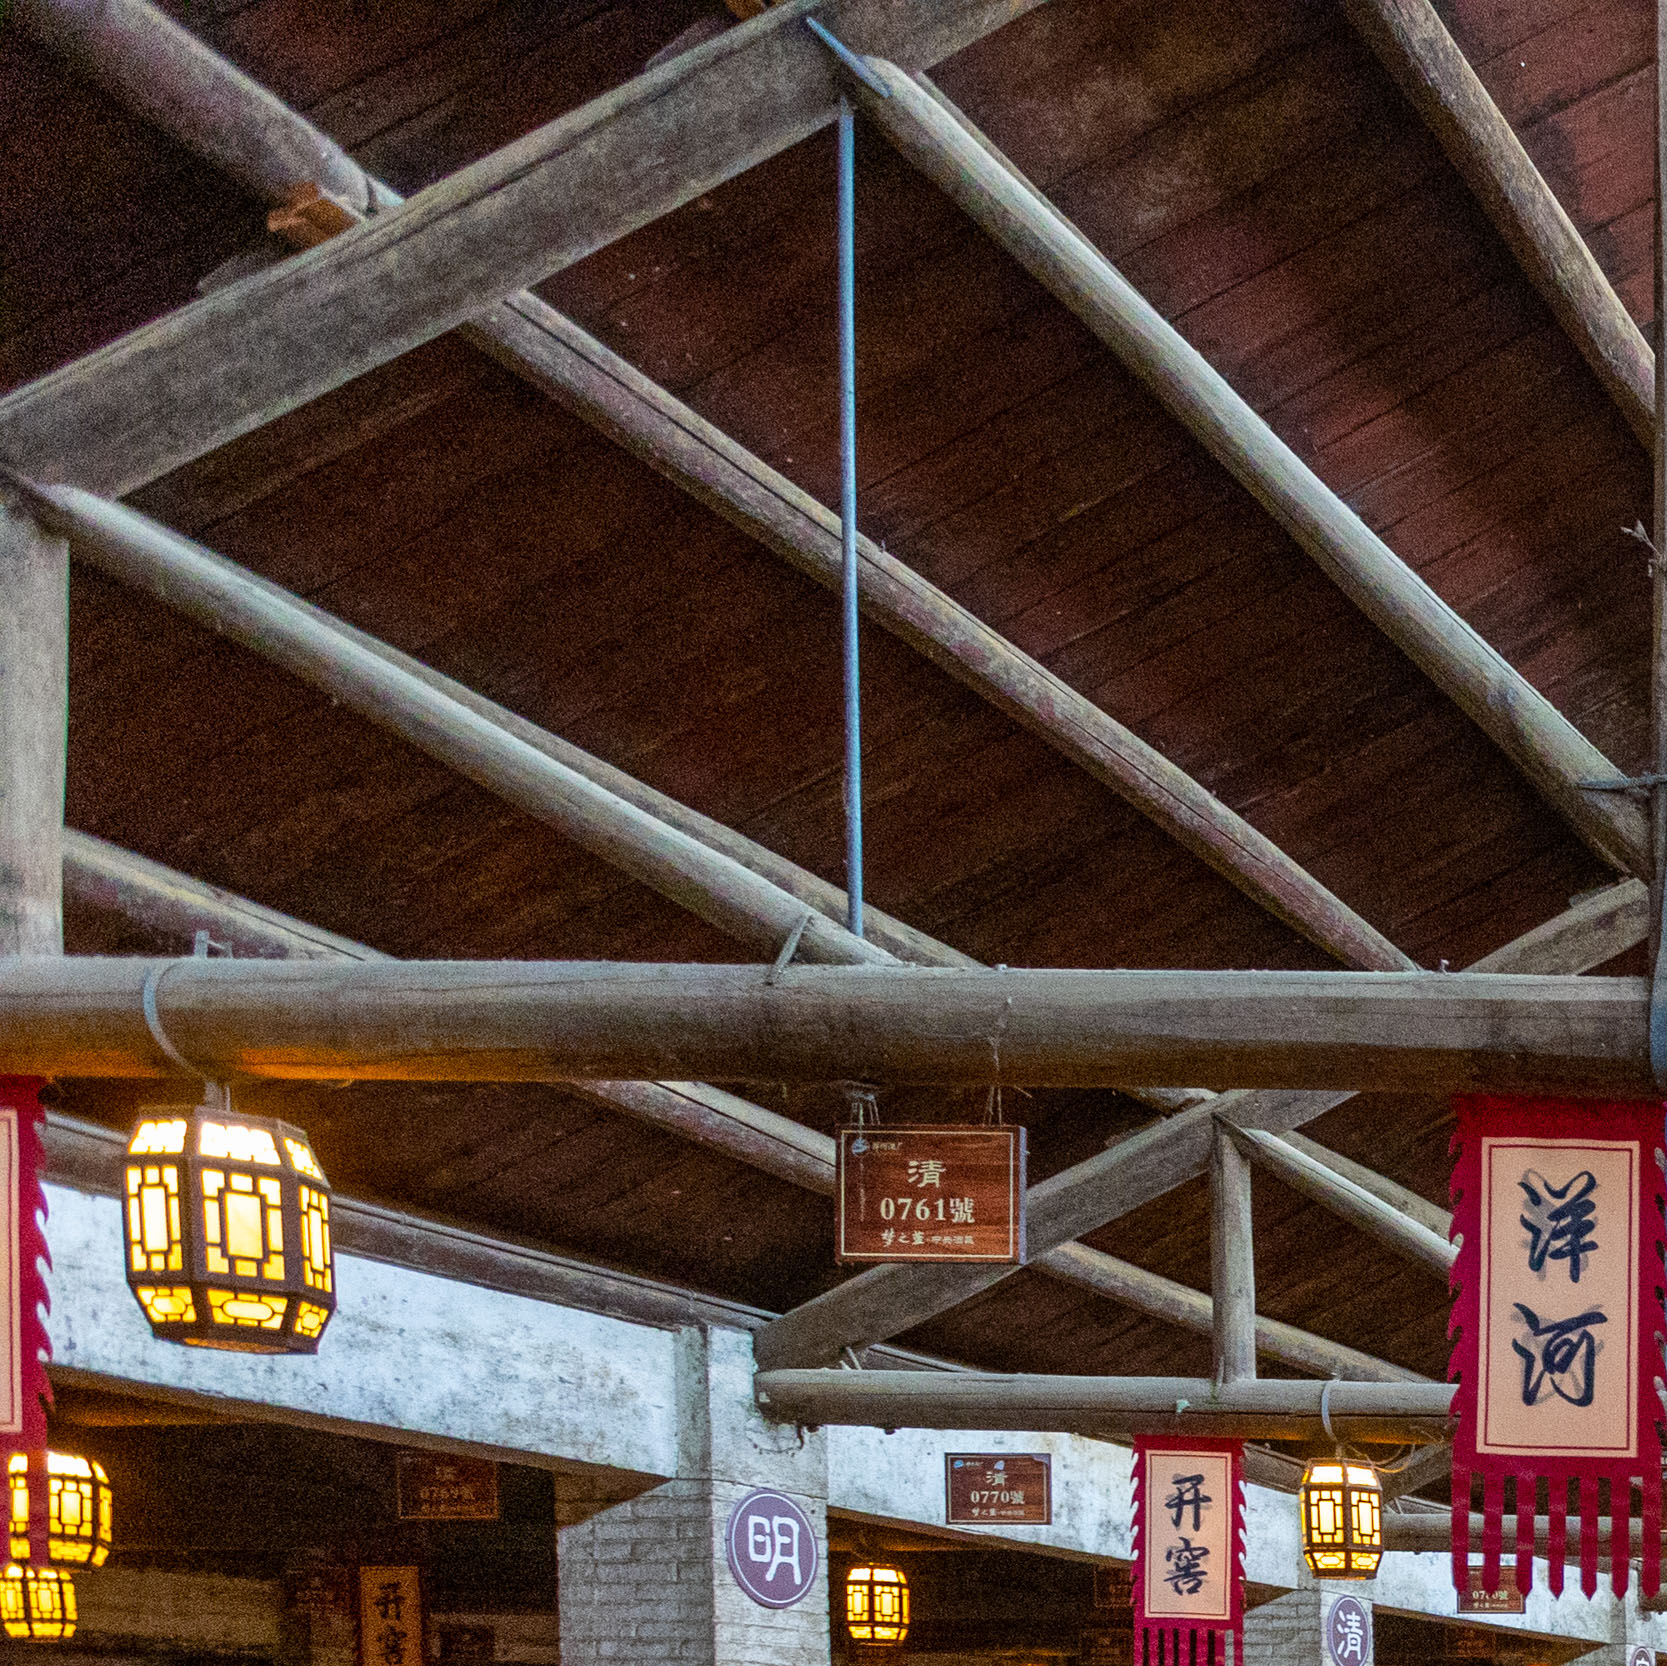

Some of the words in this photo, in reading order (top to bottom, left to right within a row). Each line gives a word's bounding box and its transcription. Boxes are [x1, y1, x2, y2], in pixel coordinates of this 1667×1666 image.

[907, 1160, 947, 1188] 清
[880, 1197, 975, 1224] 0761號
[1511, 1169, 1608, 1407] 洋河
[970, 1490, 1025, 1504] 0770號
[986, 1471, 1008, 1486] 清
[747, 1515, 802, 1585] 明
[1164, 1474, 1213, 1596] 开窖
[1336, 1610, 1363, 1660] 清
